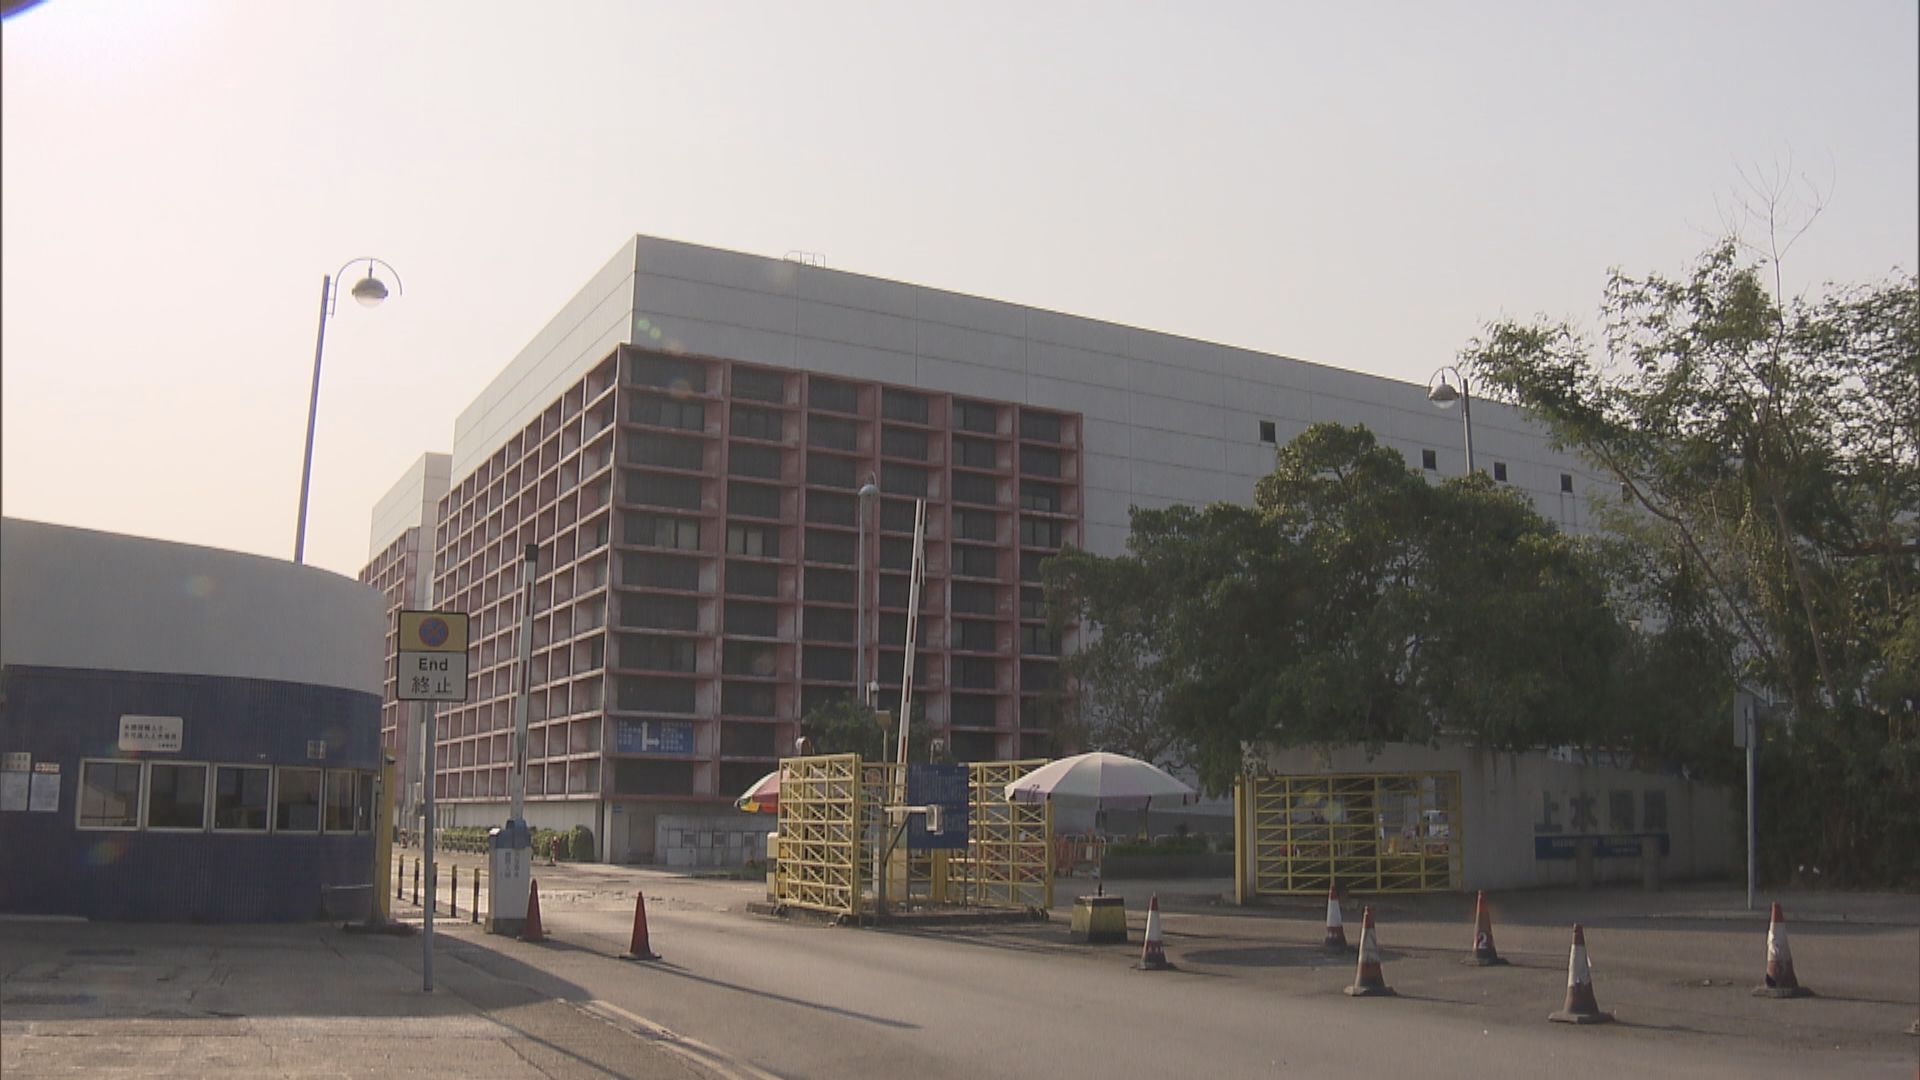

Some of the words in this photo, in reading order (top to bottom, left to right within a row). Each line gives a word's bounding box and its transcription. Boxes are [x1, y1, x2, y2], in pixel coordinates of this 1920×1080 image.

[419, 657, 448, 671] End
[411, 676, 453, 695] 終止
[1478, 931, 1488, 949] 2
